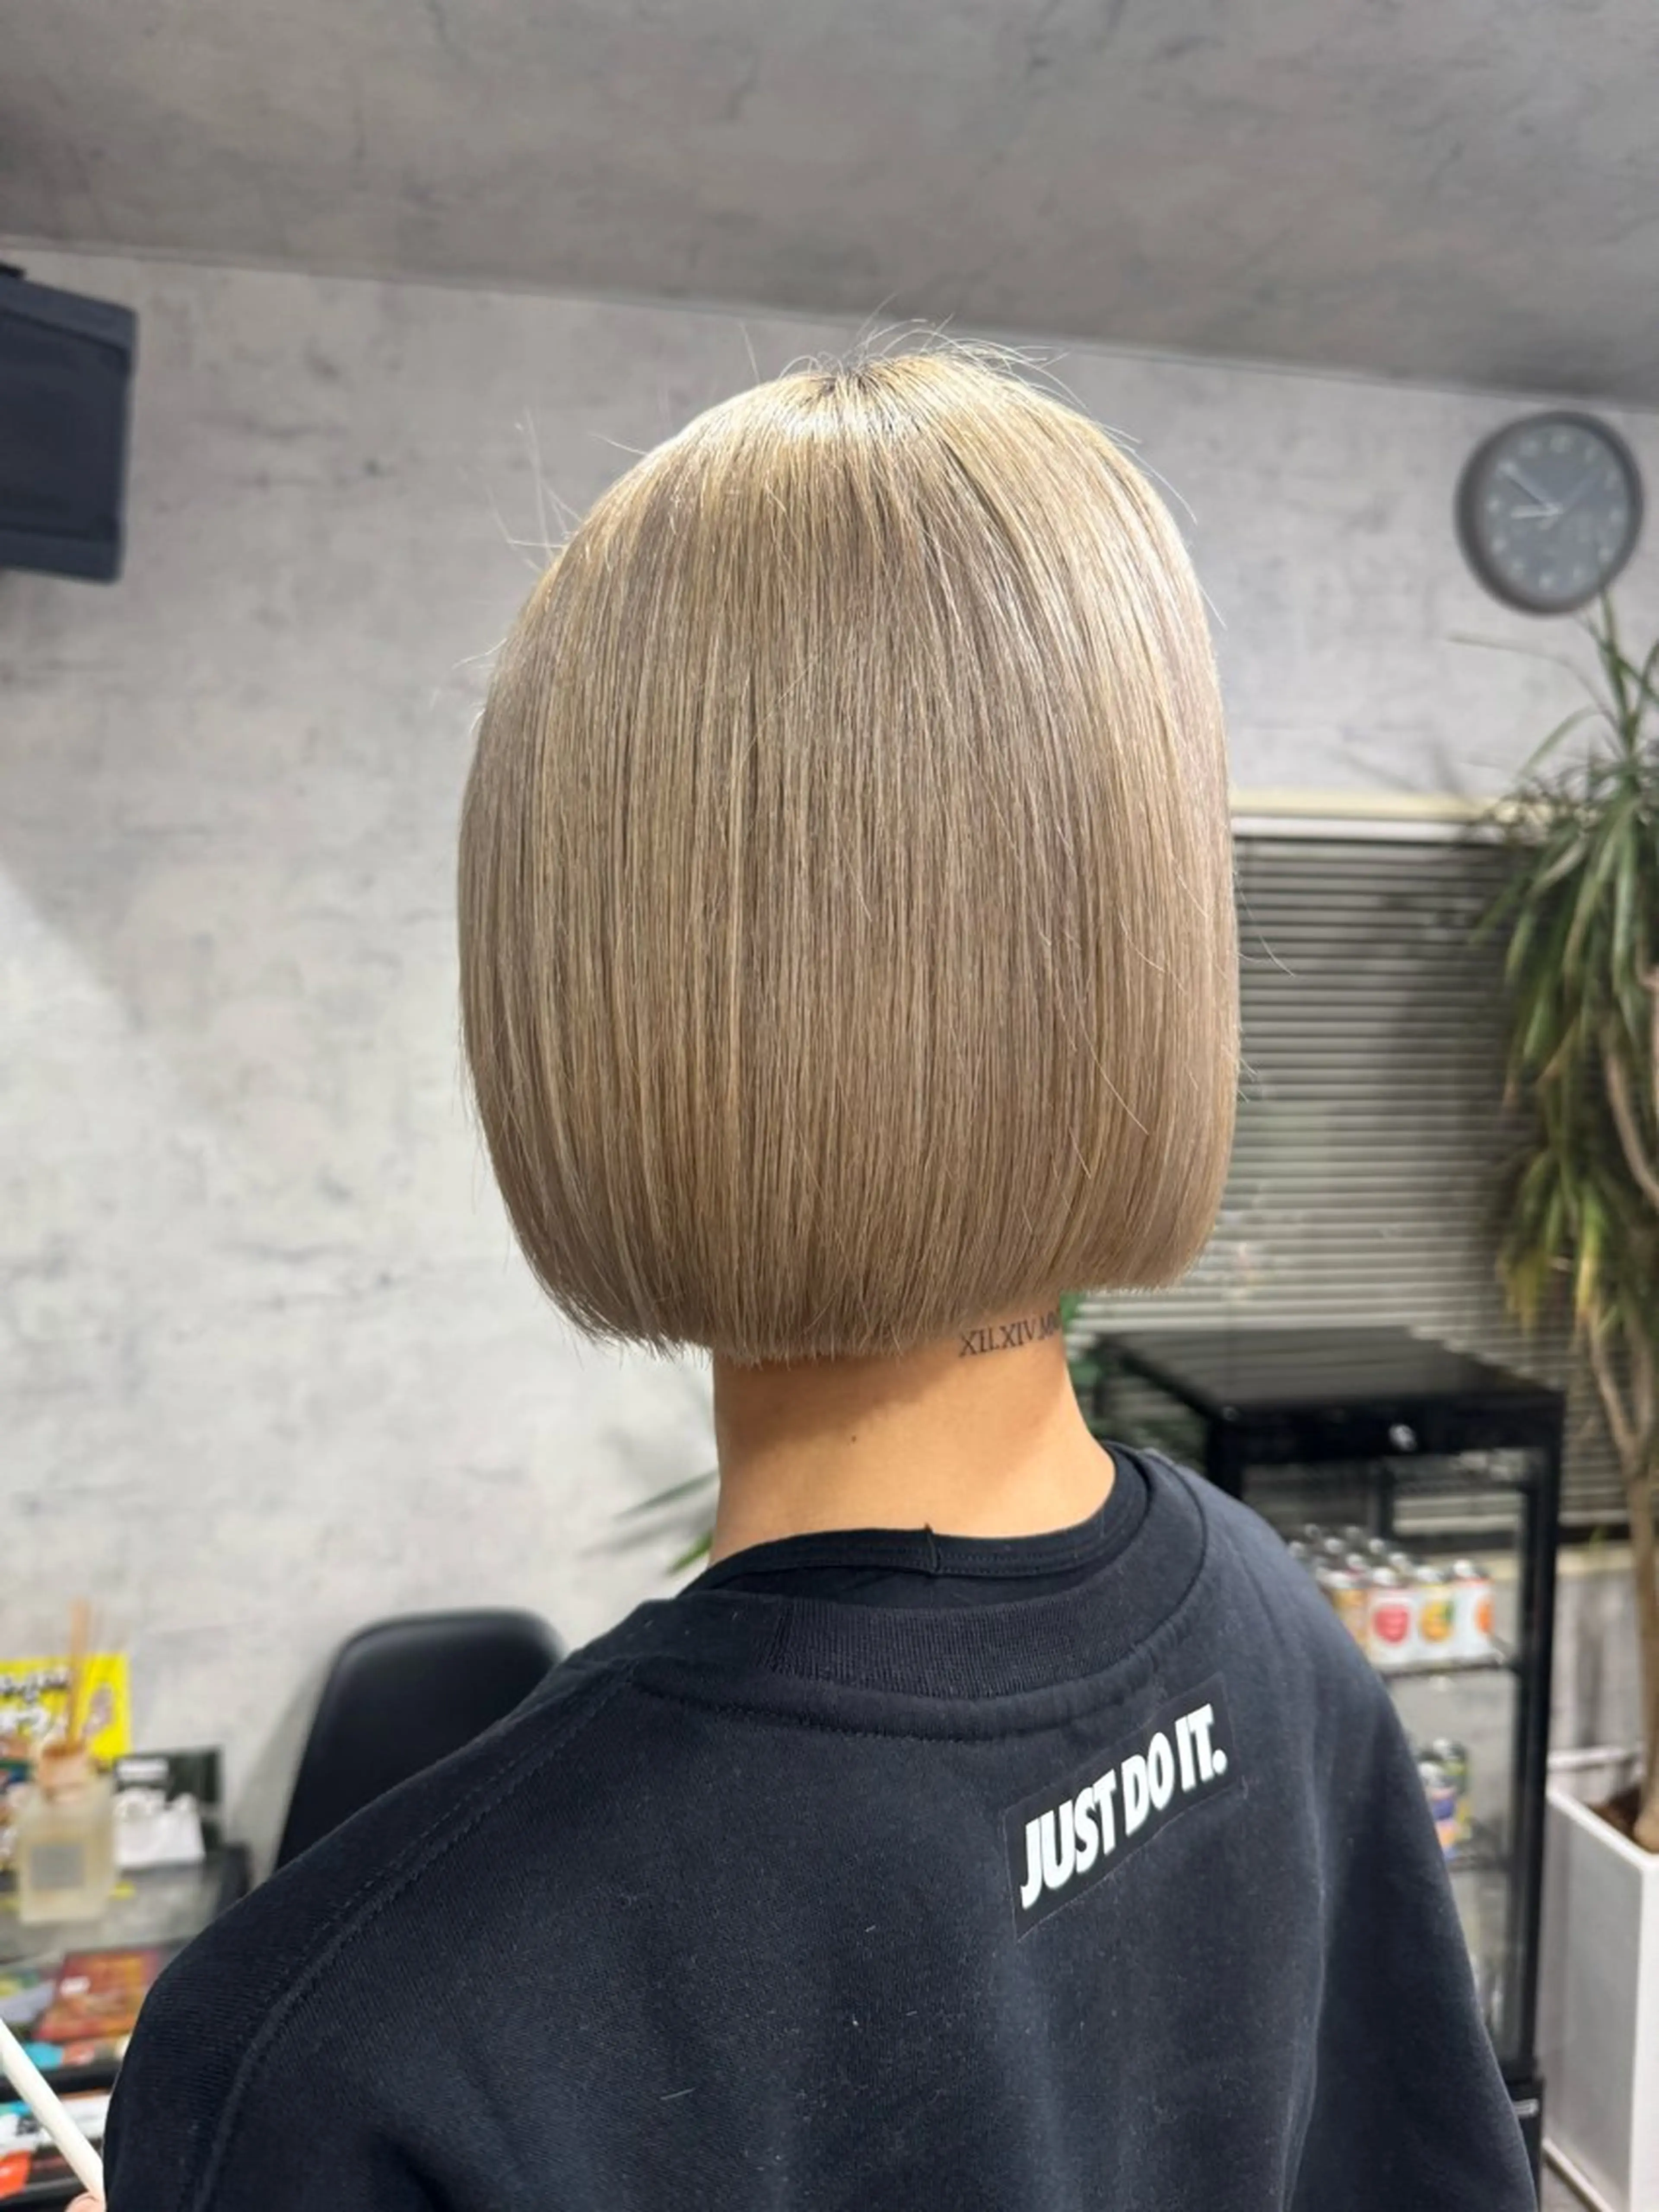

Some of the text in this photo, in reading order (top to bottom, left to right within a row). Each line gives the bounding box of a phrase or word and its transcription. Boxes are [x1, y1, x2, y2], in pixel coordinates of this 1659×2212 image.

[1020, 1703, 1227, 1909] JUST DO IT.
